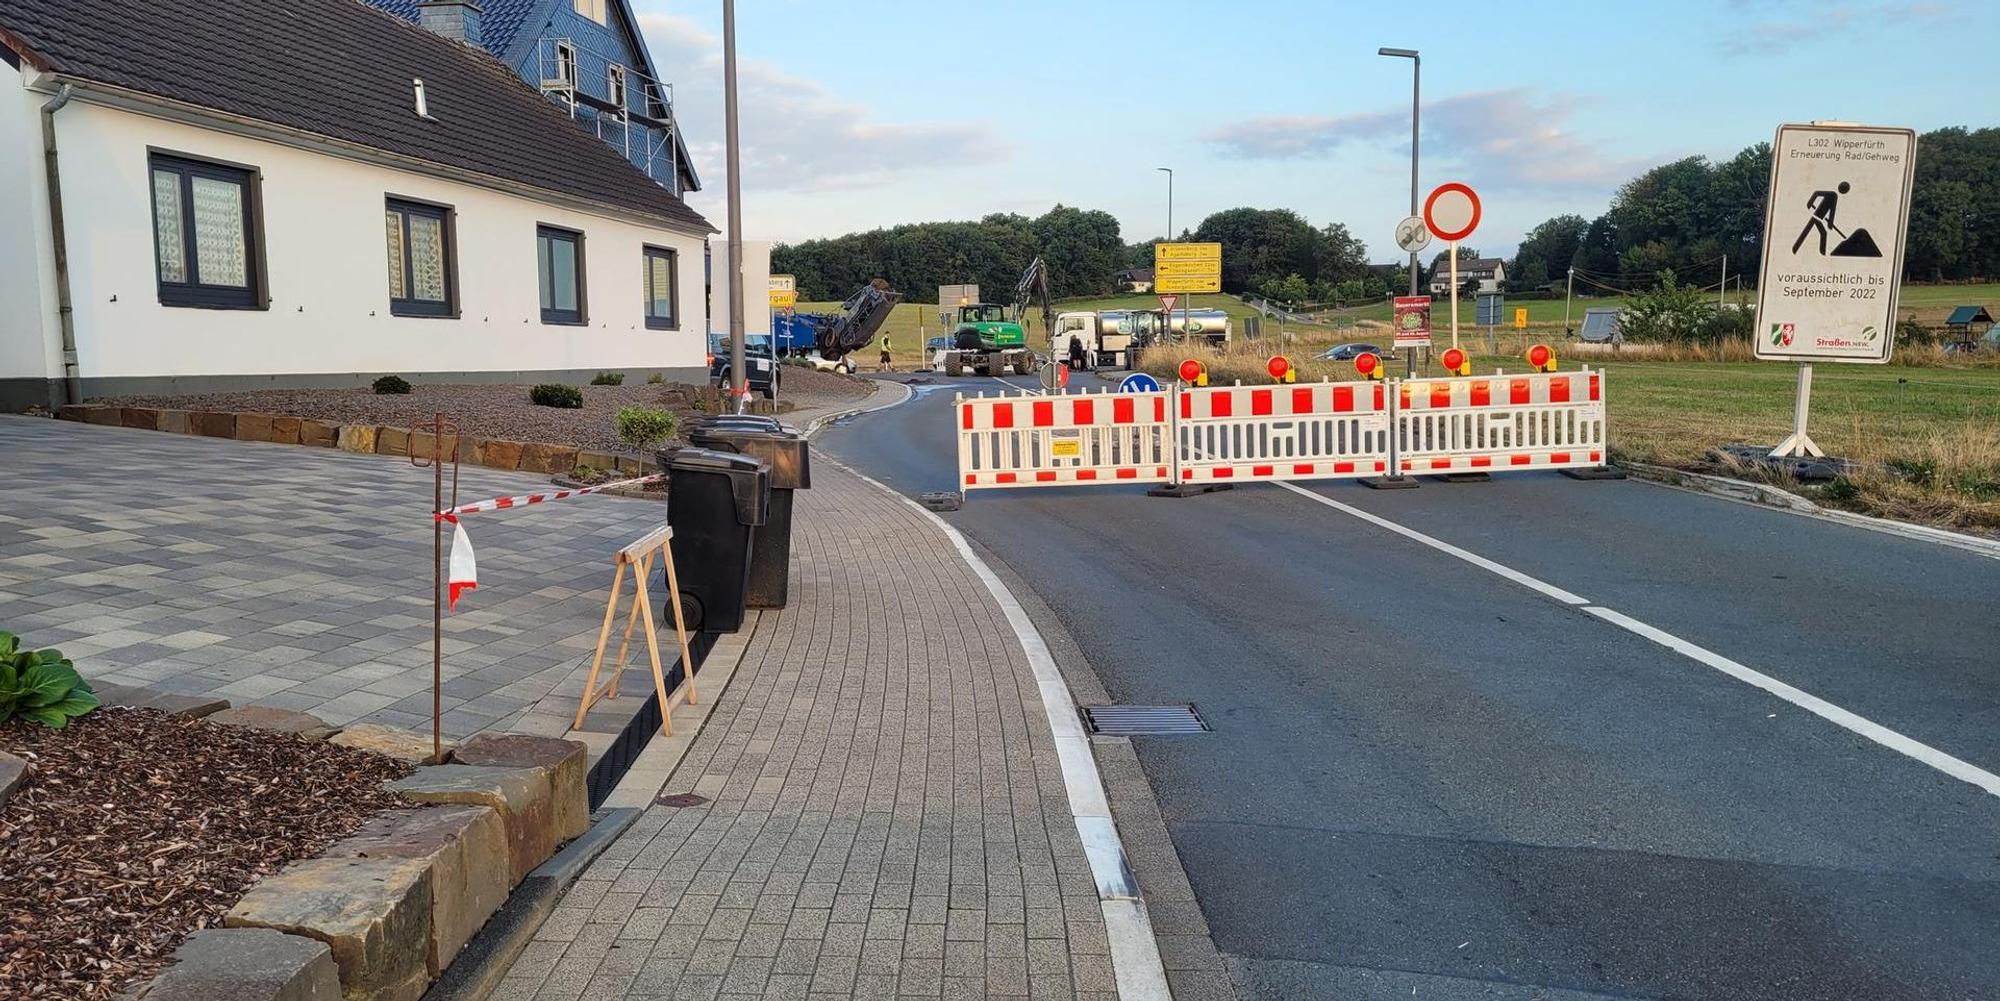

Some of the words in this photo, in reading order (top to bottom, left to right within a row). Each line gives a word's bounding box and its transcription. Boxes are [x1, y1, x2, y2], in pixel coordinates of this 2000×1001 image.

[1808, 138, 1829, 148] L302
[1834, 138, 1886, 150] Wipperfürth
[1790, 149, 1841, 161] Erneuerung
[1844, 151, 1900, 163] Rad/Gehweg
[1777, 272, 1863, 285] voraussichtlich
[1868, 274, 1885, 286] bis
[1783, 286, 1844, 299] September
[1849, 288, 1877, 300] 2022
